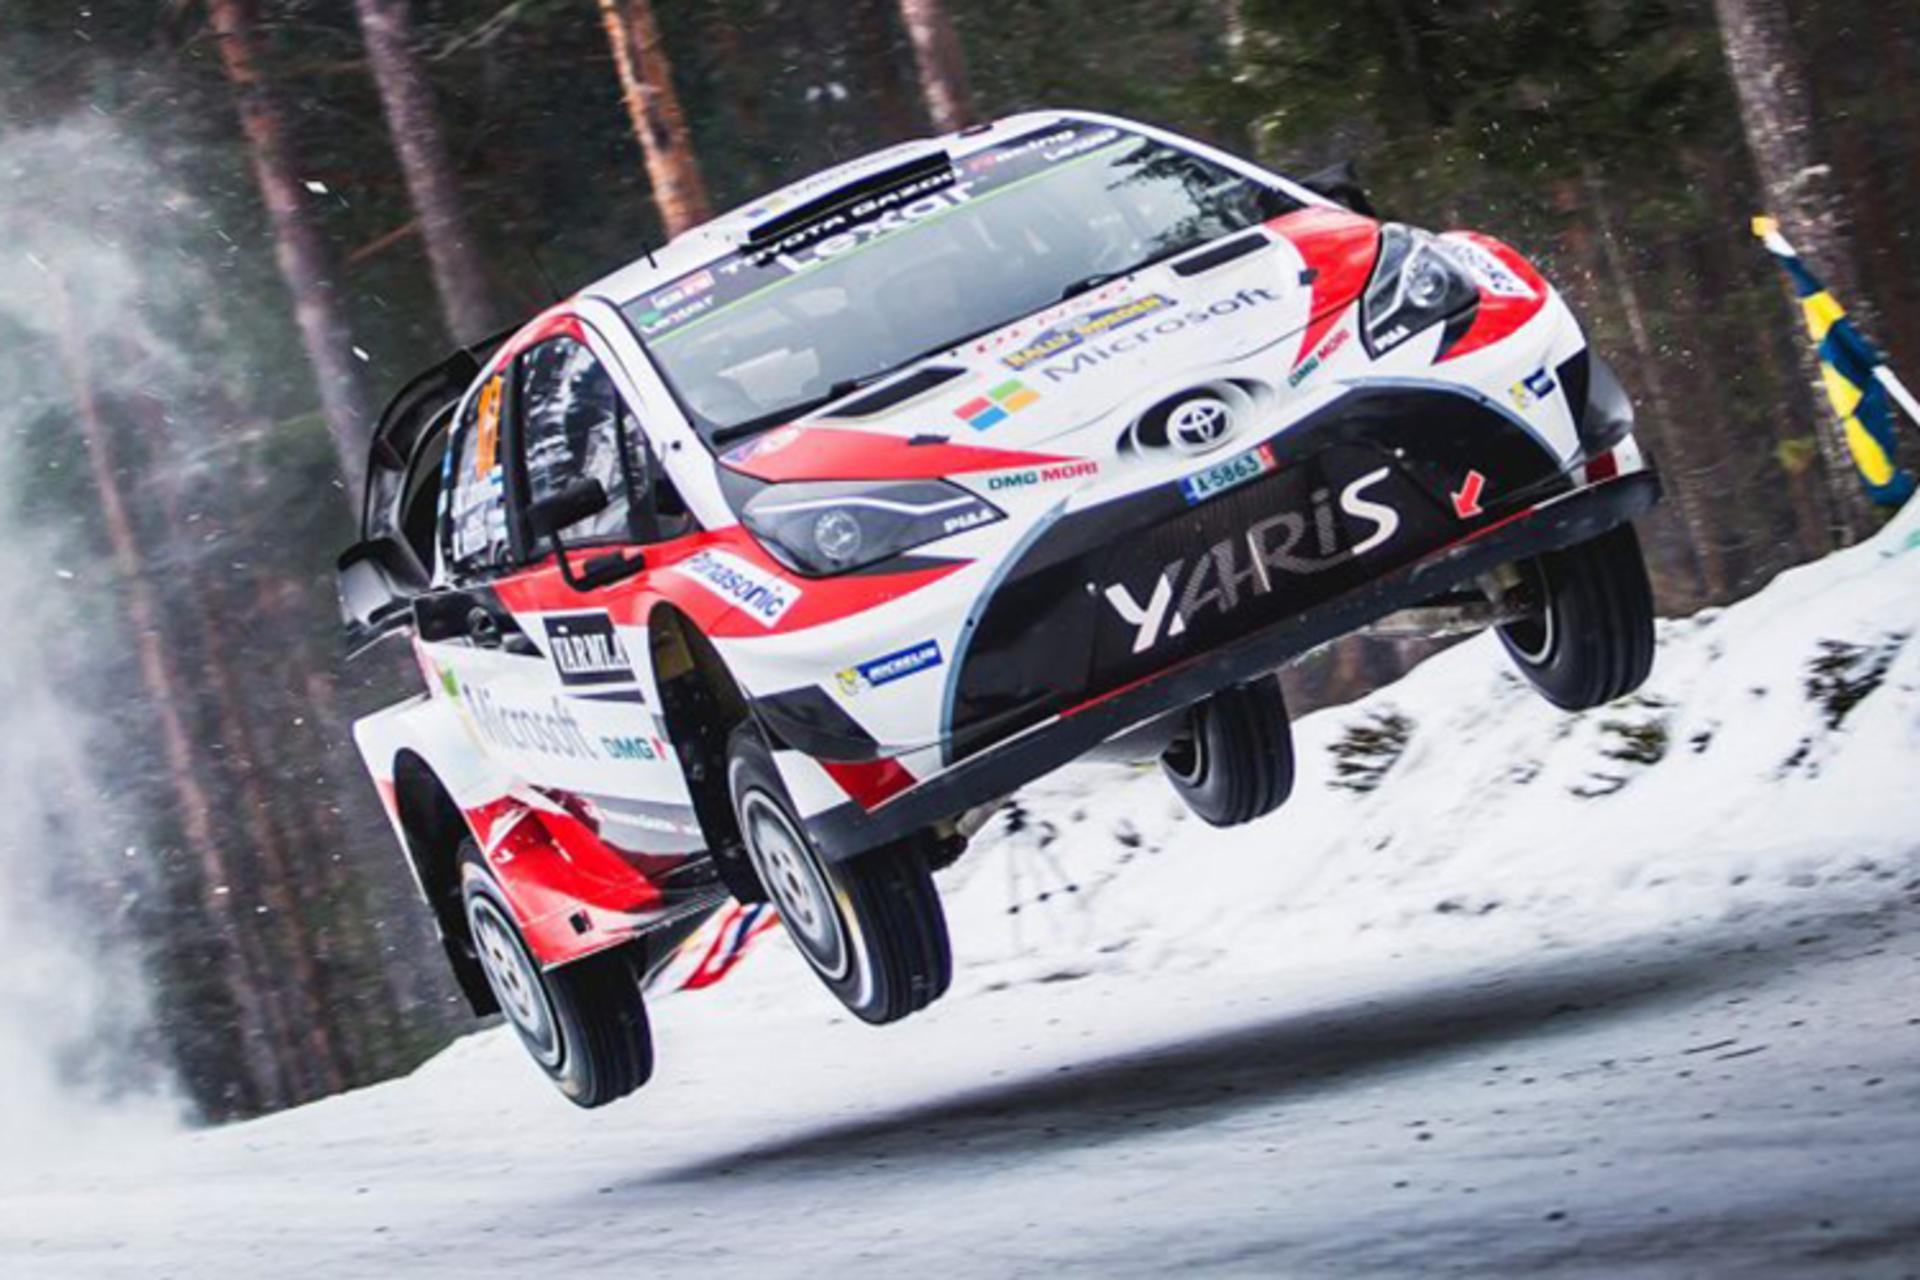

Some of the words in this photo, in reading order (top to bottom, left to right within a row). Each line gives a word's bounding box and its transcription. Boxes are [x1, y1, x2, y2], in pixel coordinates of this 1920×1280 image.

[1042, 286, 1279, 383] Microsoft
[988, 470, 1039, 491] DMG
[1040, 451, 1100, 483] MORI
[687, 551, 786, 618] Panasonic
